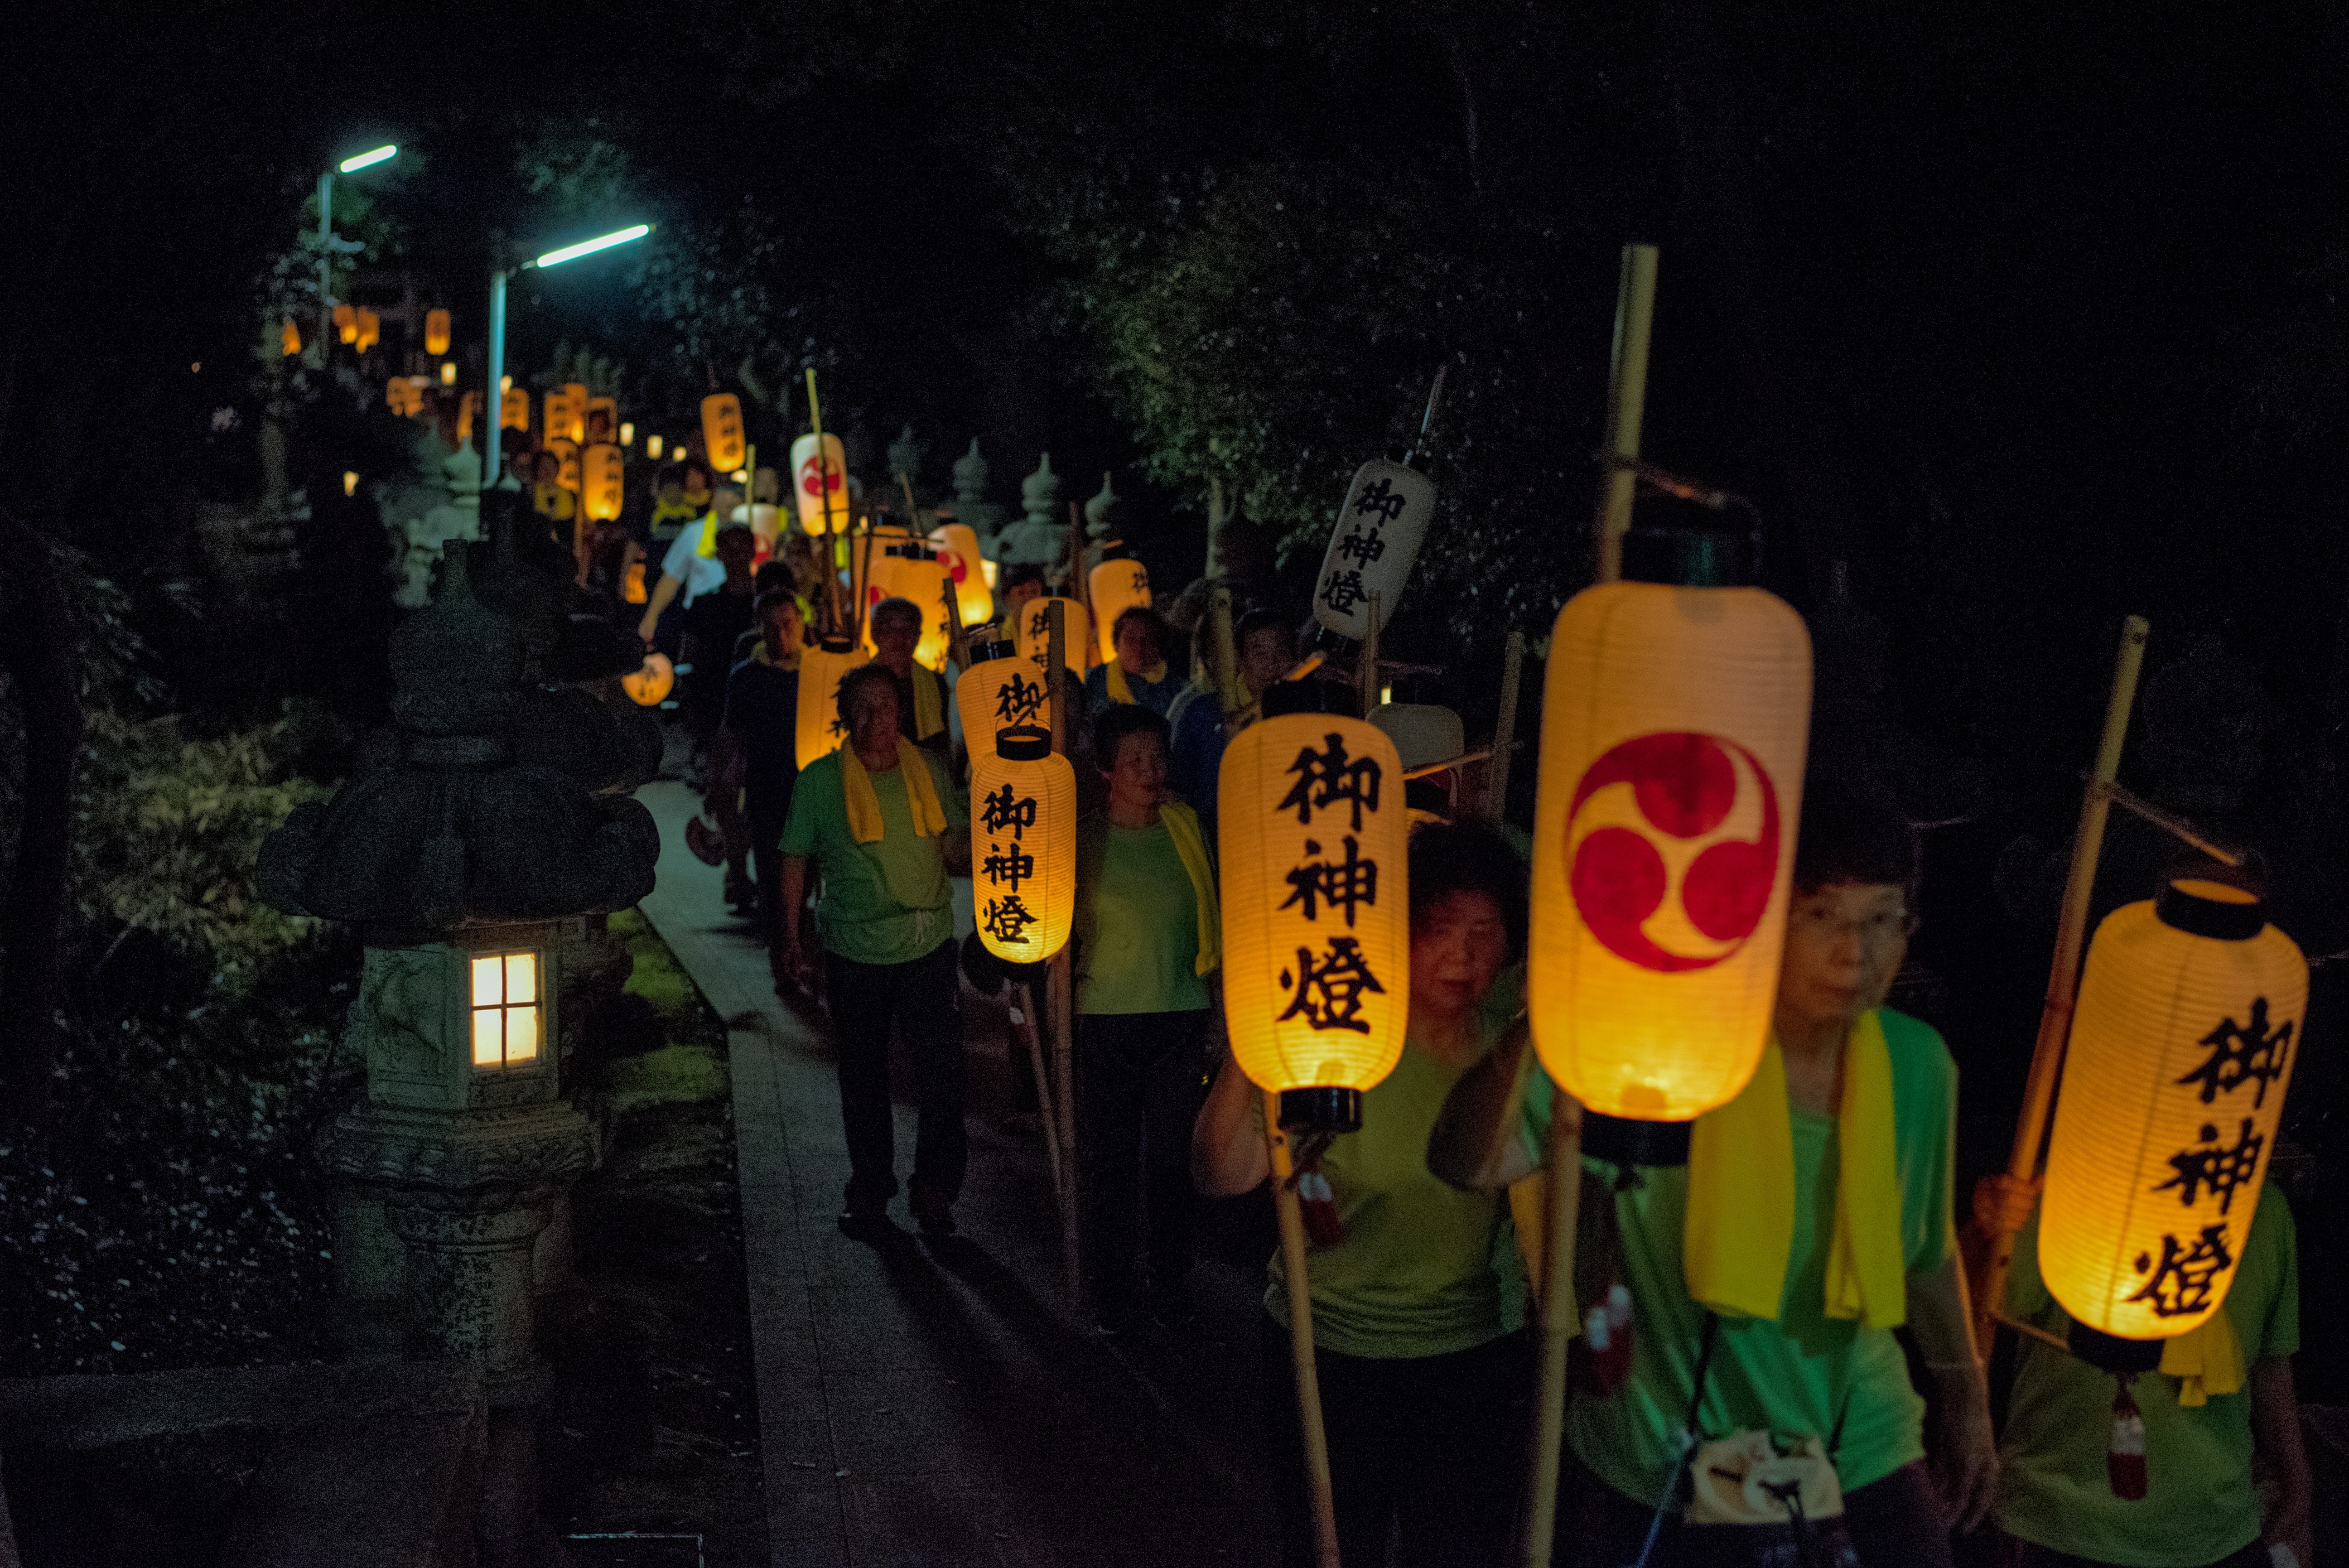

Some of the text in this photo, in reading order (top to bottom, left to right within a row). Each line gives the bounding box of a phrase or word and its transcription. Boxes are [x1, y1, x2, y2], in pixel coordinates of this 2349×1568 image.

[1320, 478, 1406, 616] 御神燈
[980, 783, 1040, 943] 御神燈
[1275, 732, 1388, 1035] 御神燈
[2123, 996, 2294, 1319] 御神燈
